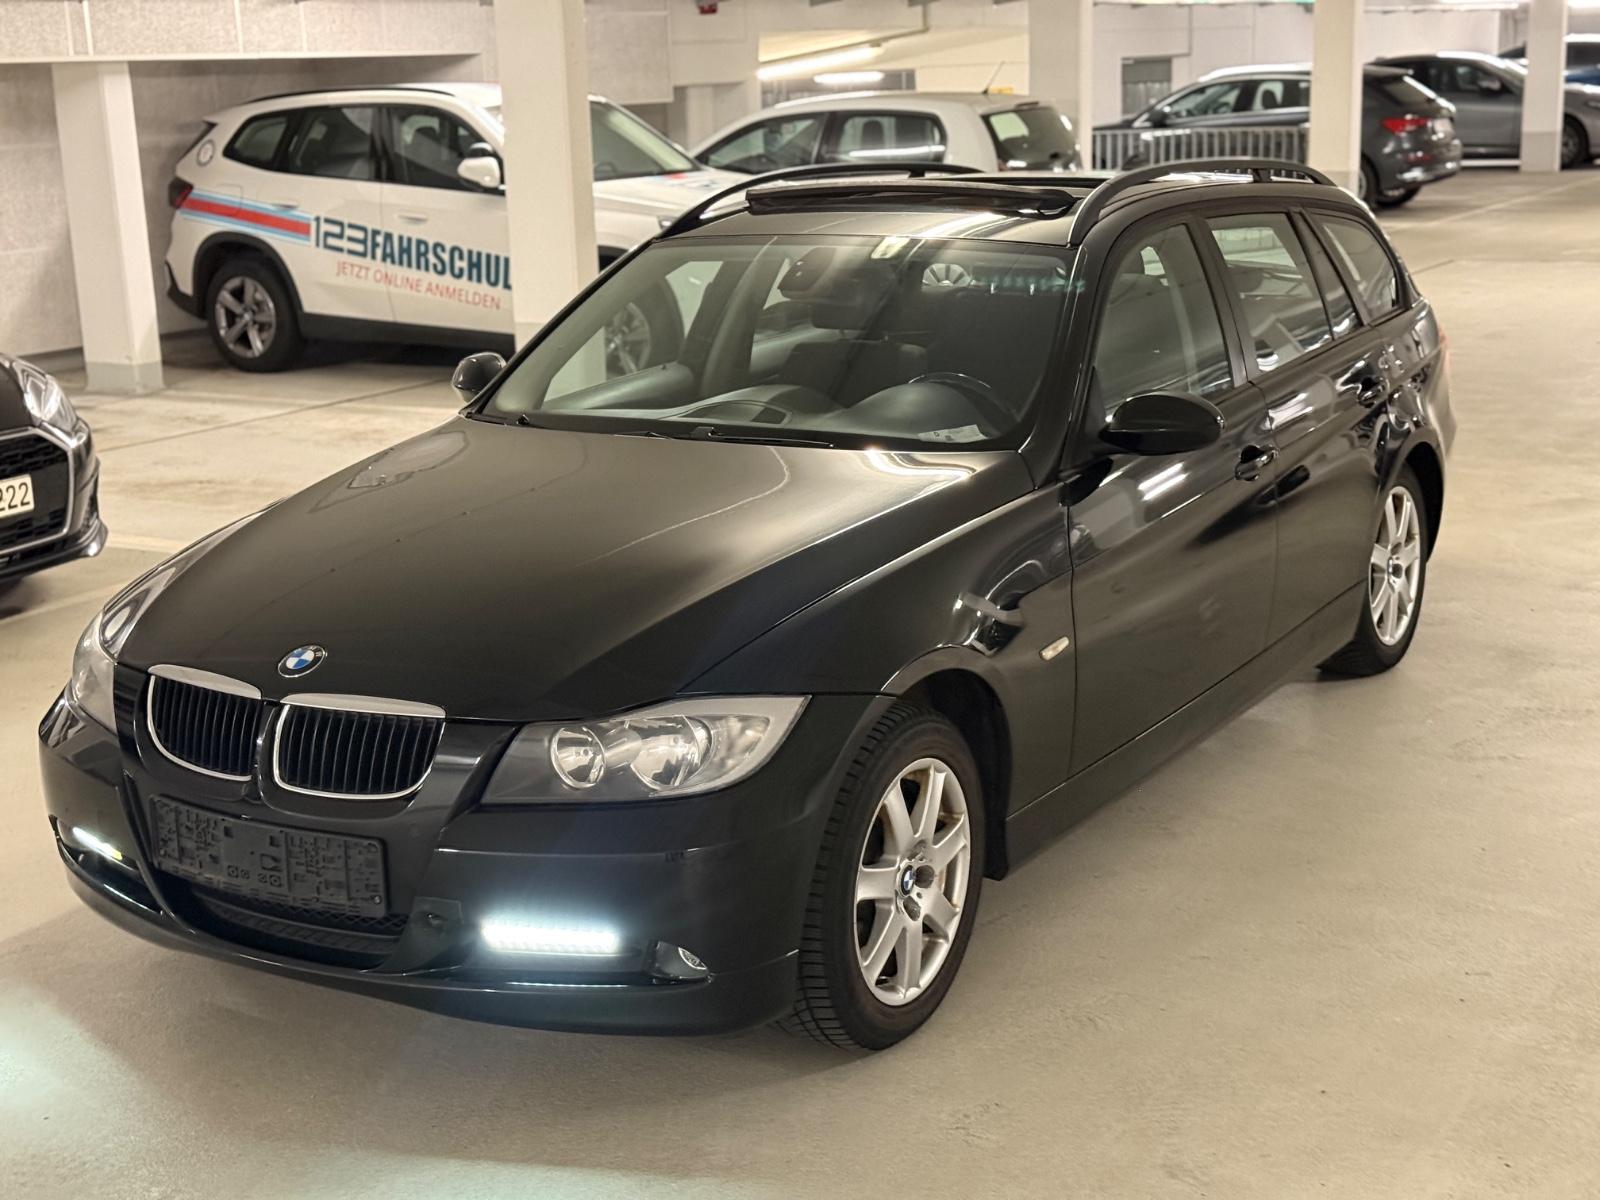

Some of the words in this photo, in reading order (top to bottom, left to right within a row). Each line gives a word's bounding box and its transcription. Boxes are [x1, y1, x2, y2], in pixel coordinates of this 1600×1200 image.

[336, 260, 370, 281] JETZT
[374, 269, 422, 293] ONLINE
[425, 284, 501, 310] ANMELDEN
